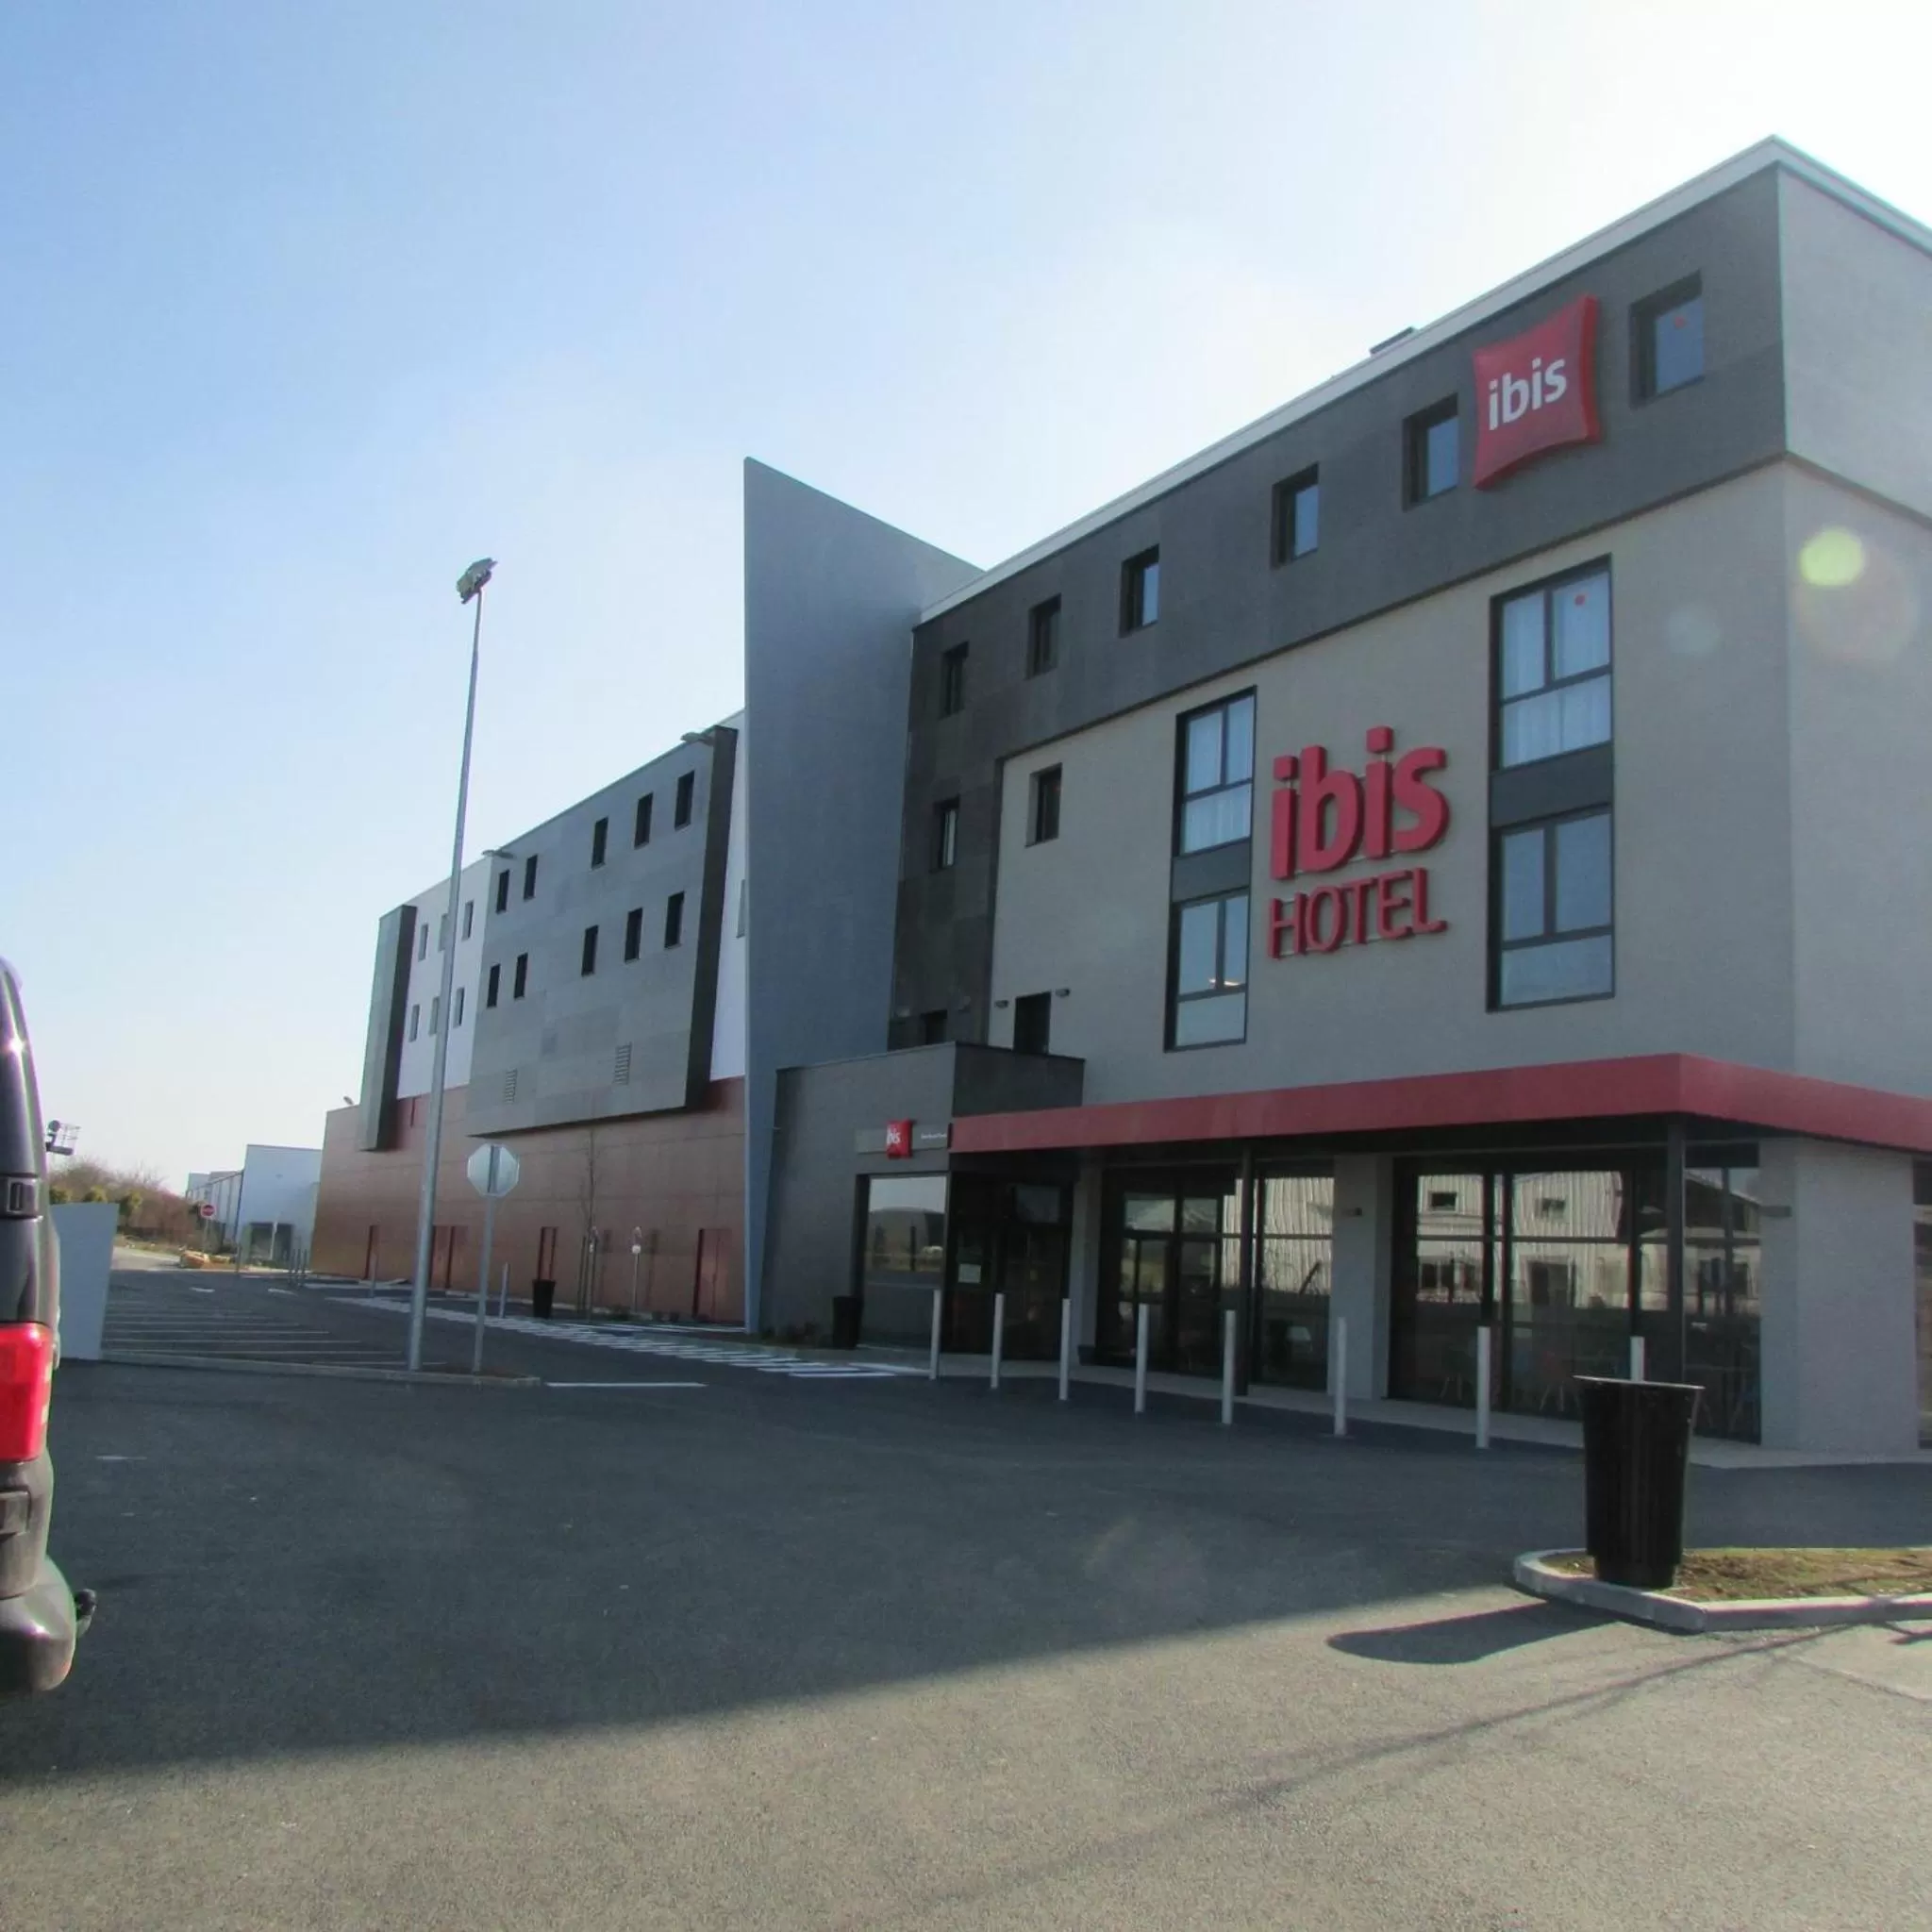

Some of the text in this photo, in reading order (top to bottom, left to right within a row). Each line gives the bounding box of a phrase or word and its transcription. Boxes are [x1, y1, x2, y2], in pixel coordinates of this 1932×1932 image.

[1489, 358, 1567, 430] ibis
[1270, 725, 1450, 880] ibis
[1267, 867, 1448, 958] HOTEL
